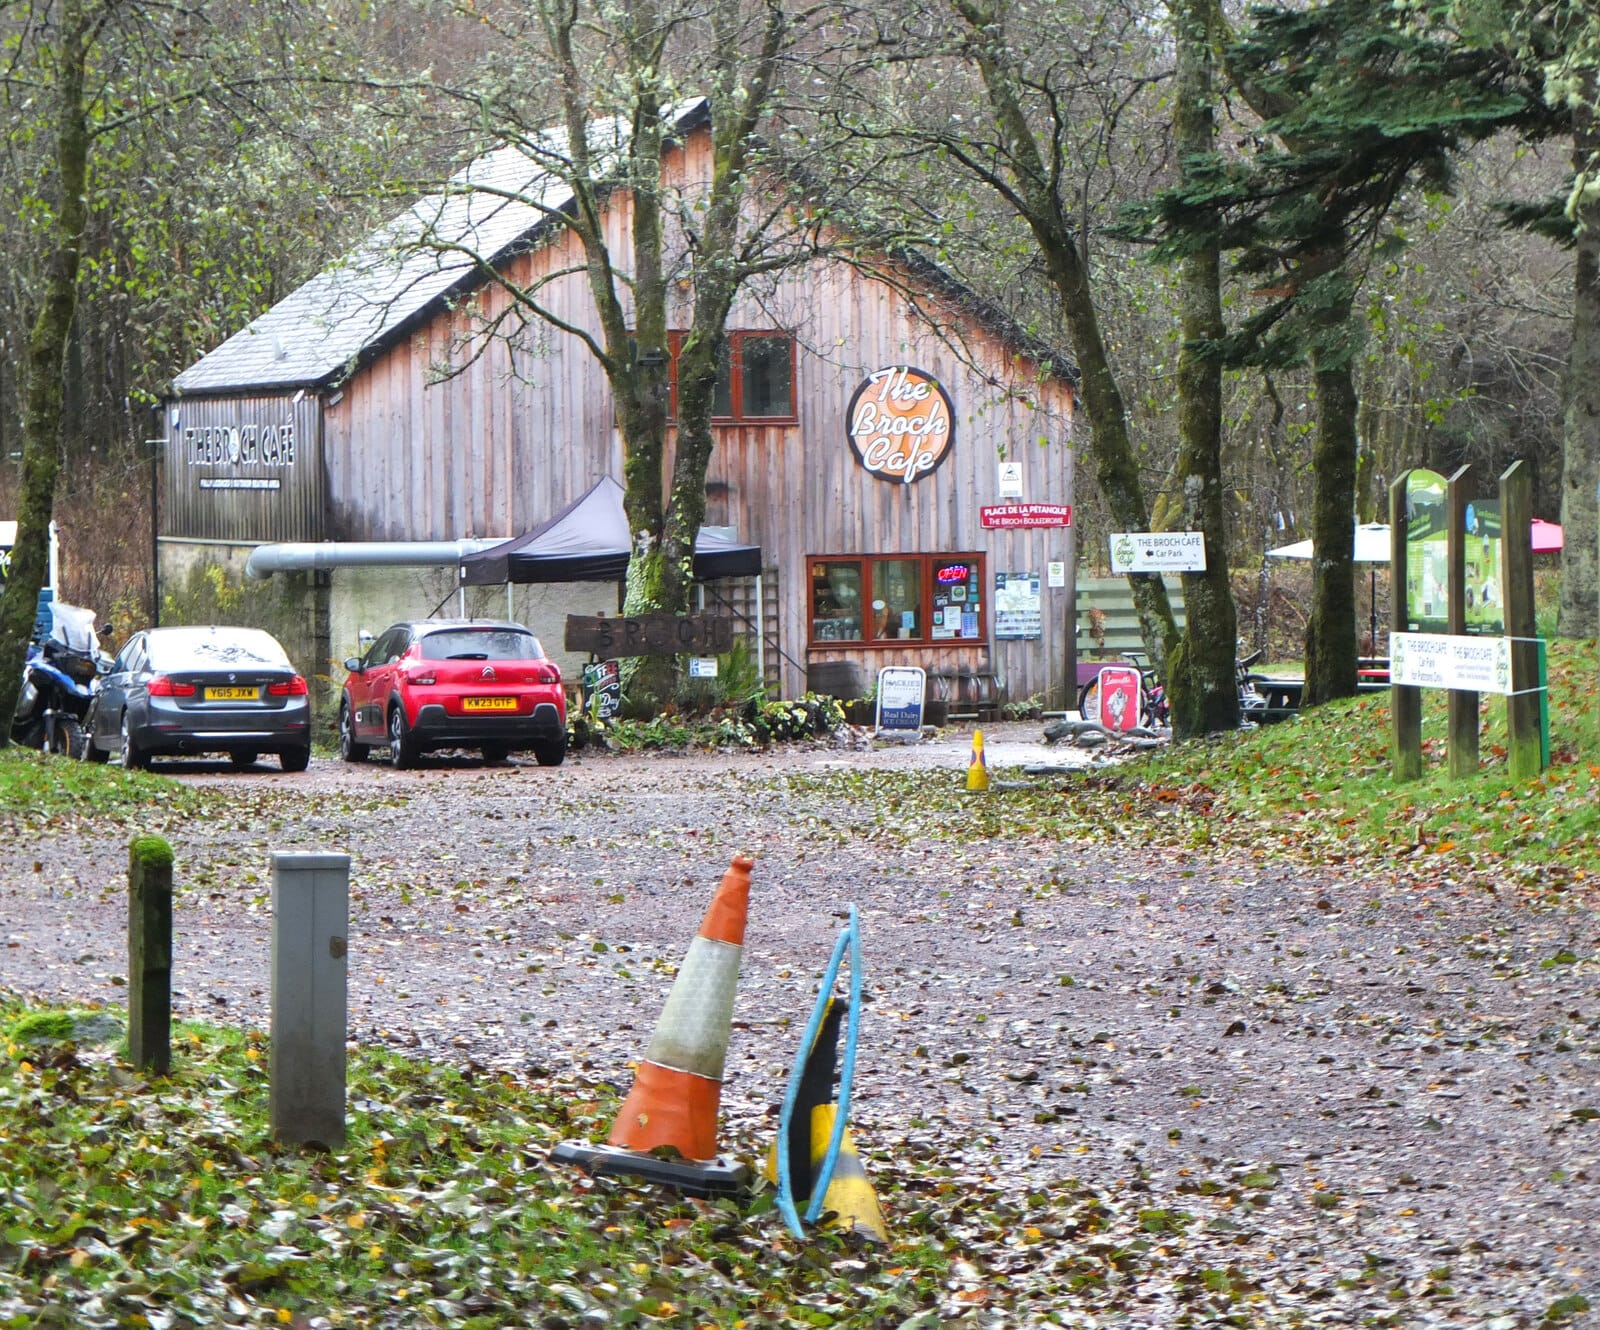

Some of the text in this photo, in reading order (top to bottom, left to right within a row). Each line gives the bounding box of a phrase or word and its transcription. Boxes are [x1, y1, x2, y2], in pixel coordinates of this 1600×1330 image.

[869, 366, 931, 402] The
[850, 400, 946, 436] Broch
[185, 426, 212, 465] THE
[261, 412, 295, 467] CAFÉ
[863, 436, 935, 483] Cafe
[984, 507, 1007, 517] PLACE
[1008, 506, 1018, 514] DE
[1019, 505, 1029, 514] LA
[1001, 517, 1023, 525] BROCH
[1138, 537, 1201, 547] THE BROCH CAFÉ
[1155, 549, 1183, 558] Car Park
[938, 567, 968, 579] OPEN
[599, 618, 718, 649] BRCH
[234, 687, 253, 697] JXW
[494, 698, 513, 707] GTF
[884, 711, 919, 720] Real Dairy
